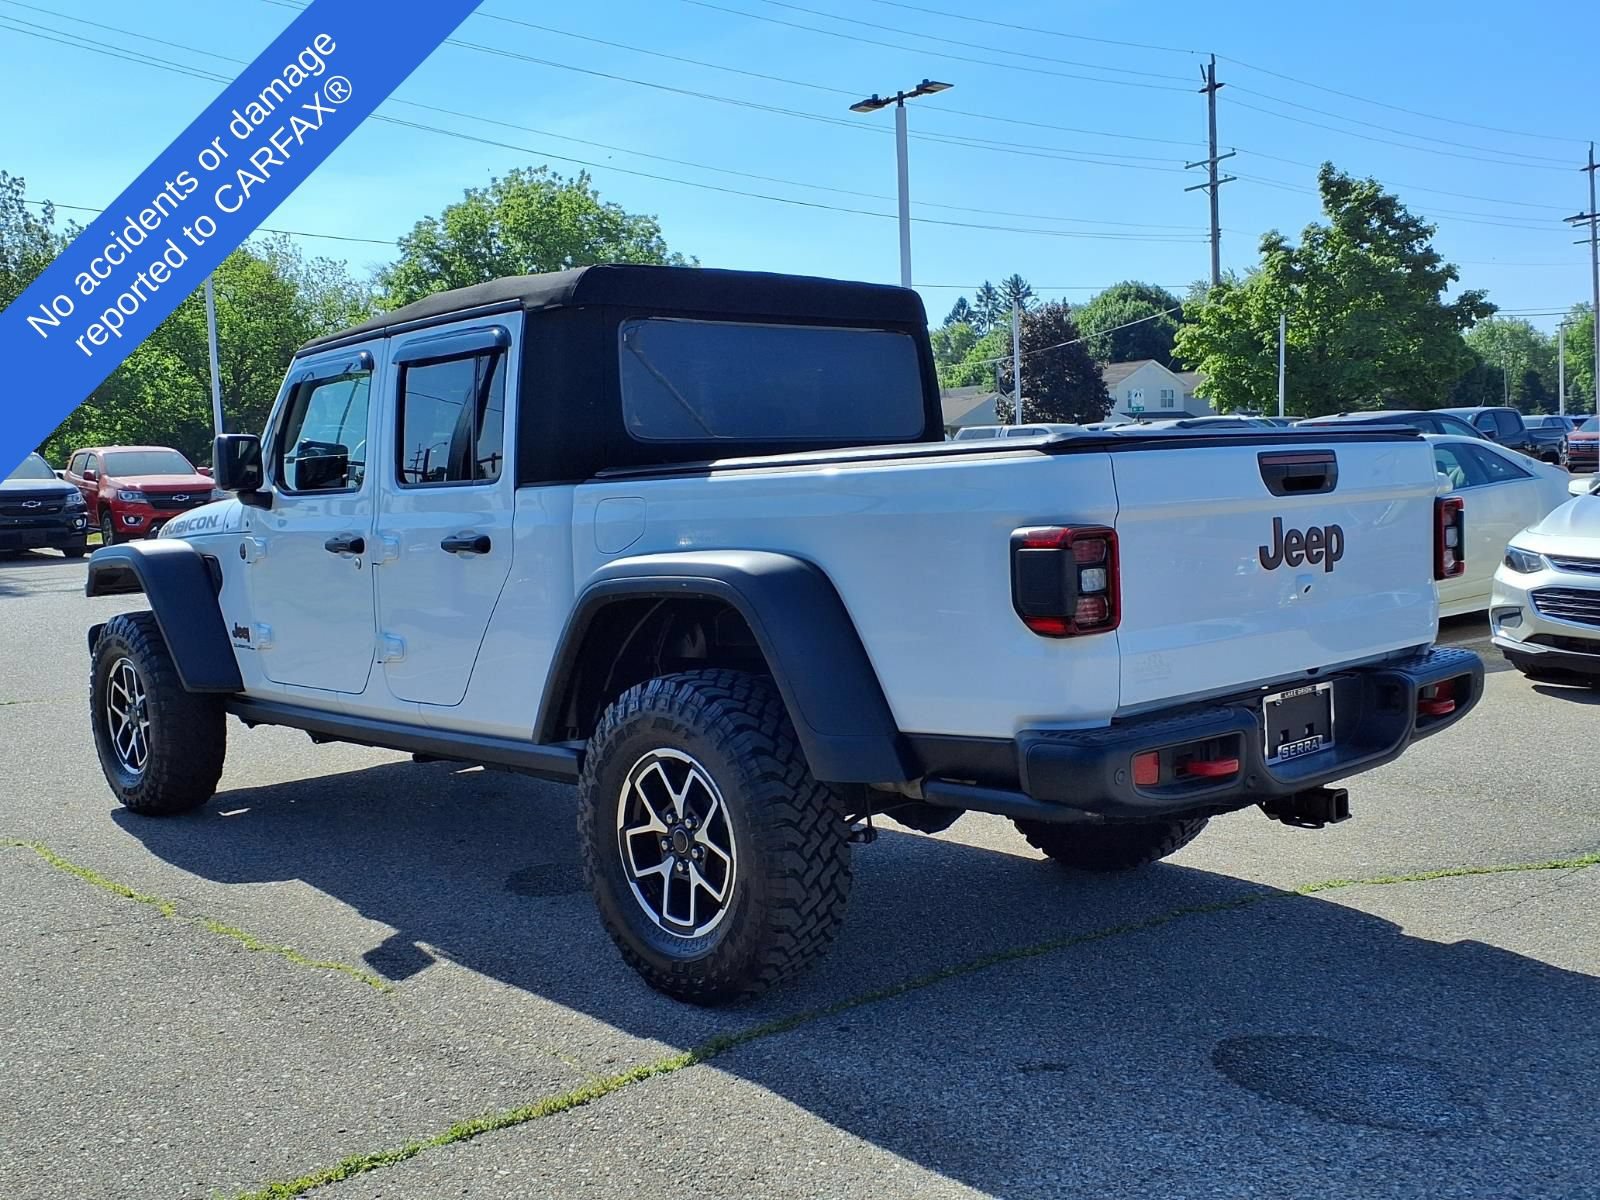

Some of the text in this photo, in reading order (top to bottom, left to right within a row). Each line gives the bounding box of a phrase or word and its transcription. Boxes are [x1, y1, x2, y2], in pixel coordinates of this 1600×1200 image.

[160, 515, 219, 536] RUBICON
[1258, 516, 1345, 573] Jeep
[231, 621, 251, 643] Jeep
[1282, 739, 1319, 758] SERRA
